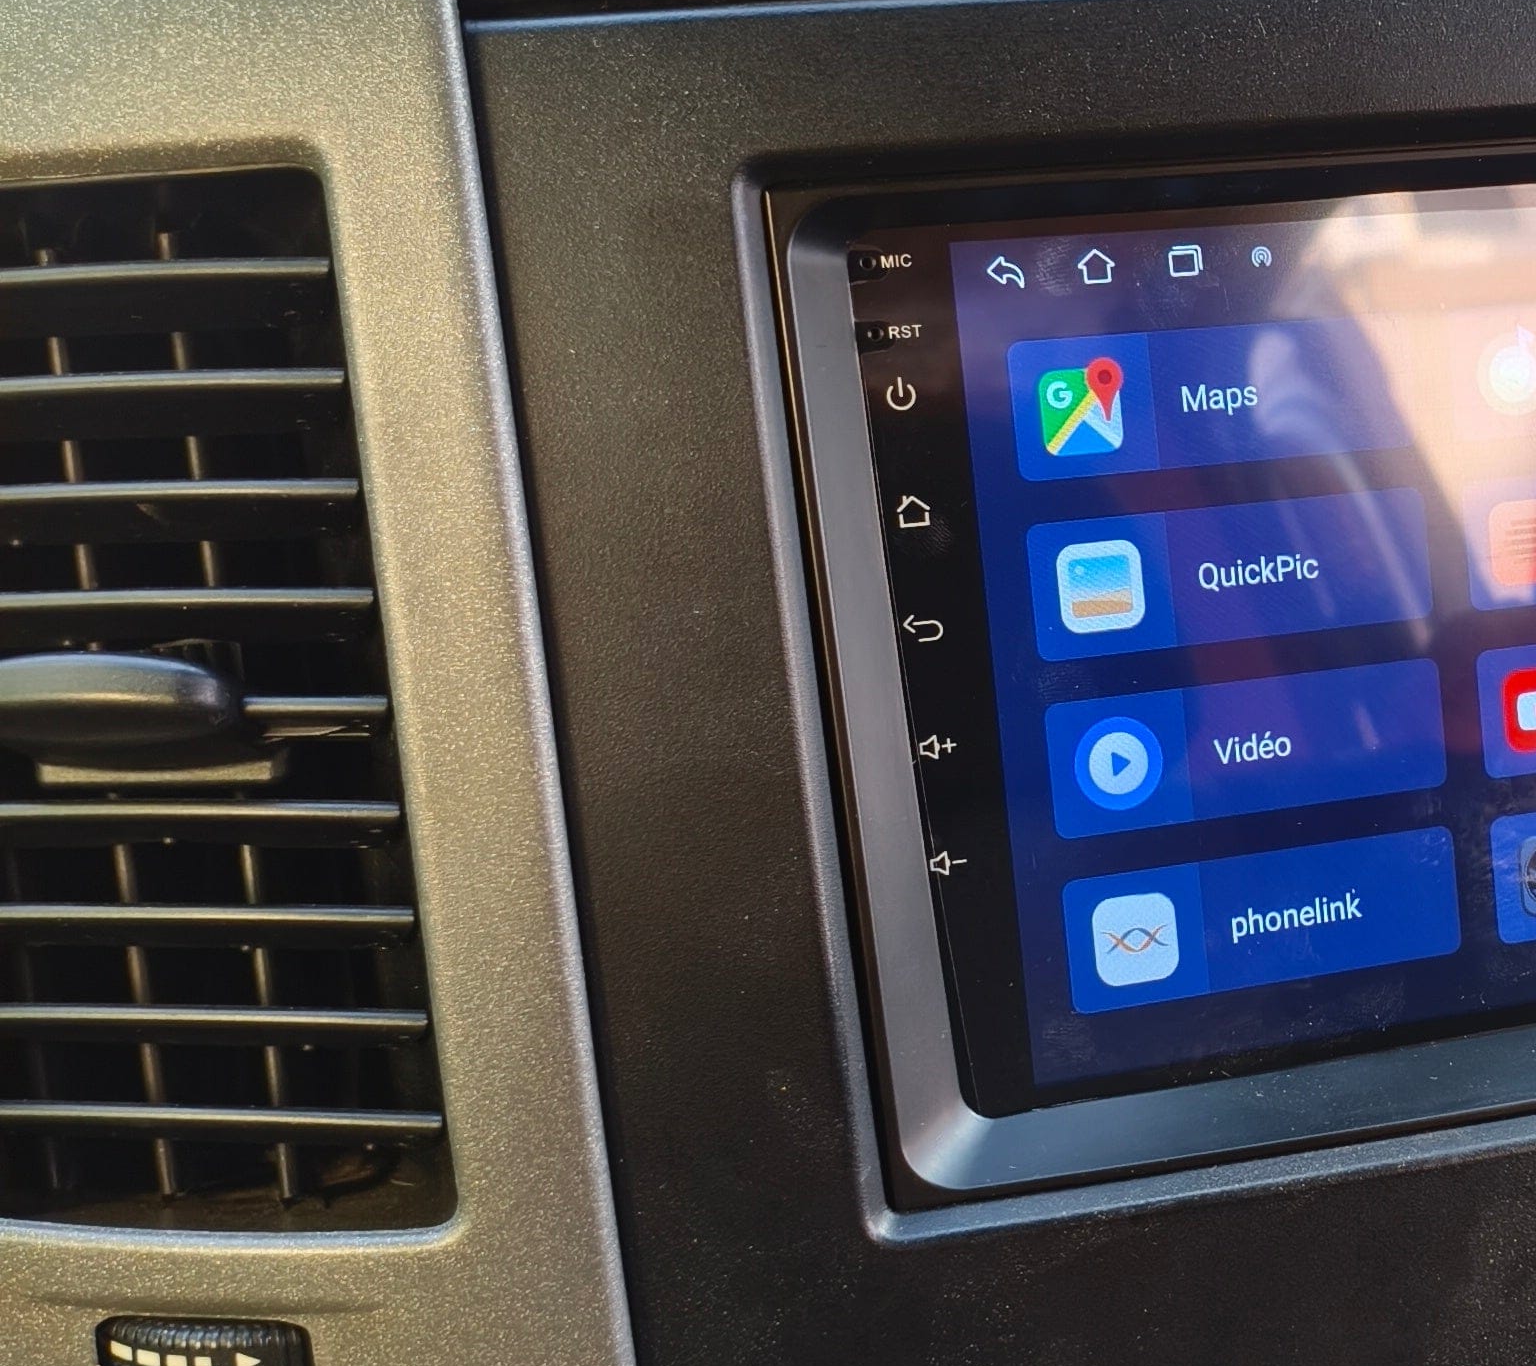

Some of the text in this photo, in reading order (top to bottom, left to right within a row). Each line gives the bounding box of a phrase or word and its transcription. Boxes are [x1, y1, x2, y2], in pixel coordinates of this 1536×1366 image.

[880, 253, 913, 269] MIC
[888, 324, 922, 339] RST
[1046, 380, 1074, 410] G
[1181, 384, 1258, 415] Maps
[1198, 554, 1320, 589] QuickPic
[1214, 731, 1291, 765] Vidéo
[1231, 893, 1362, 943] phonelink
